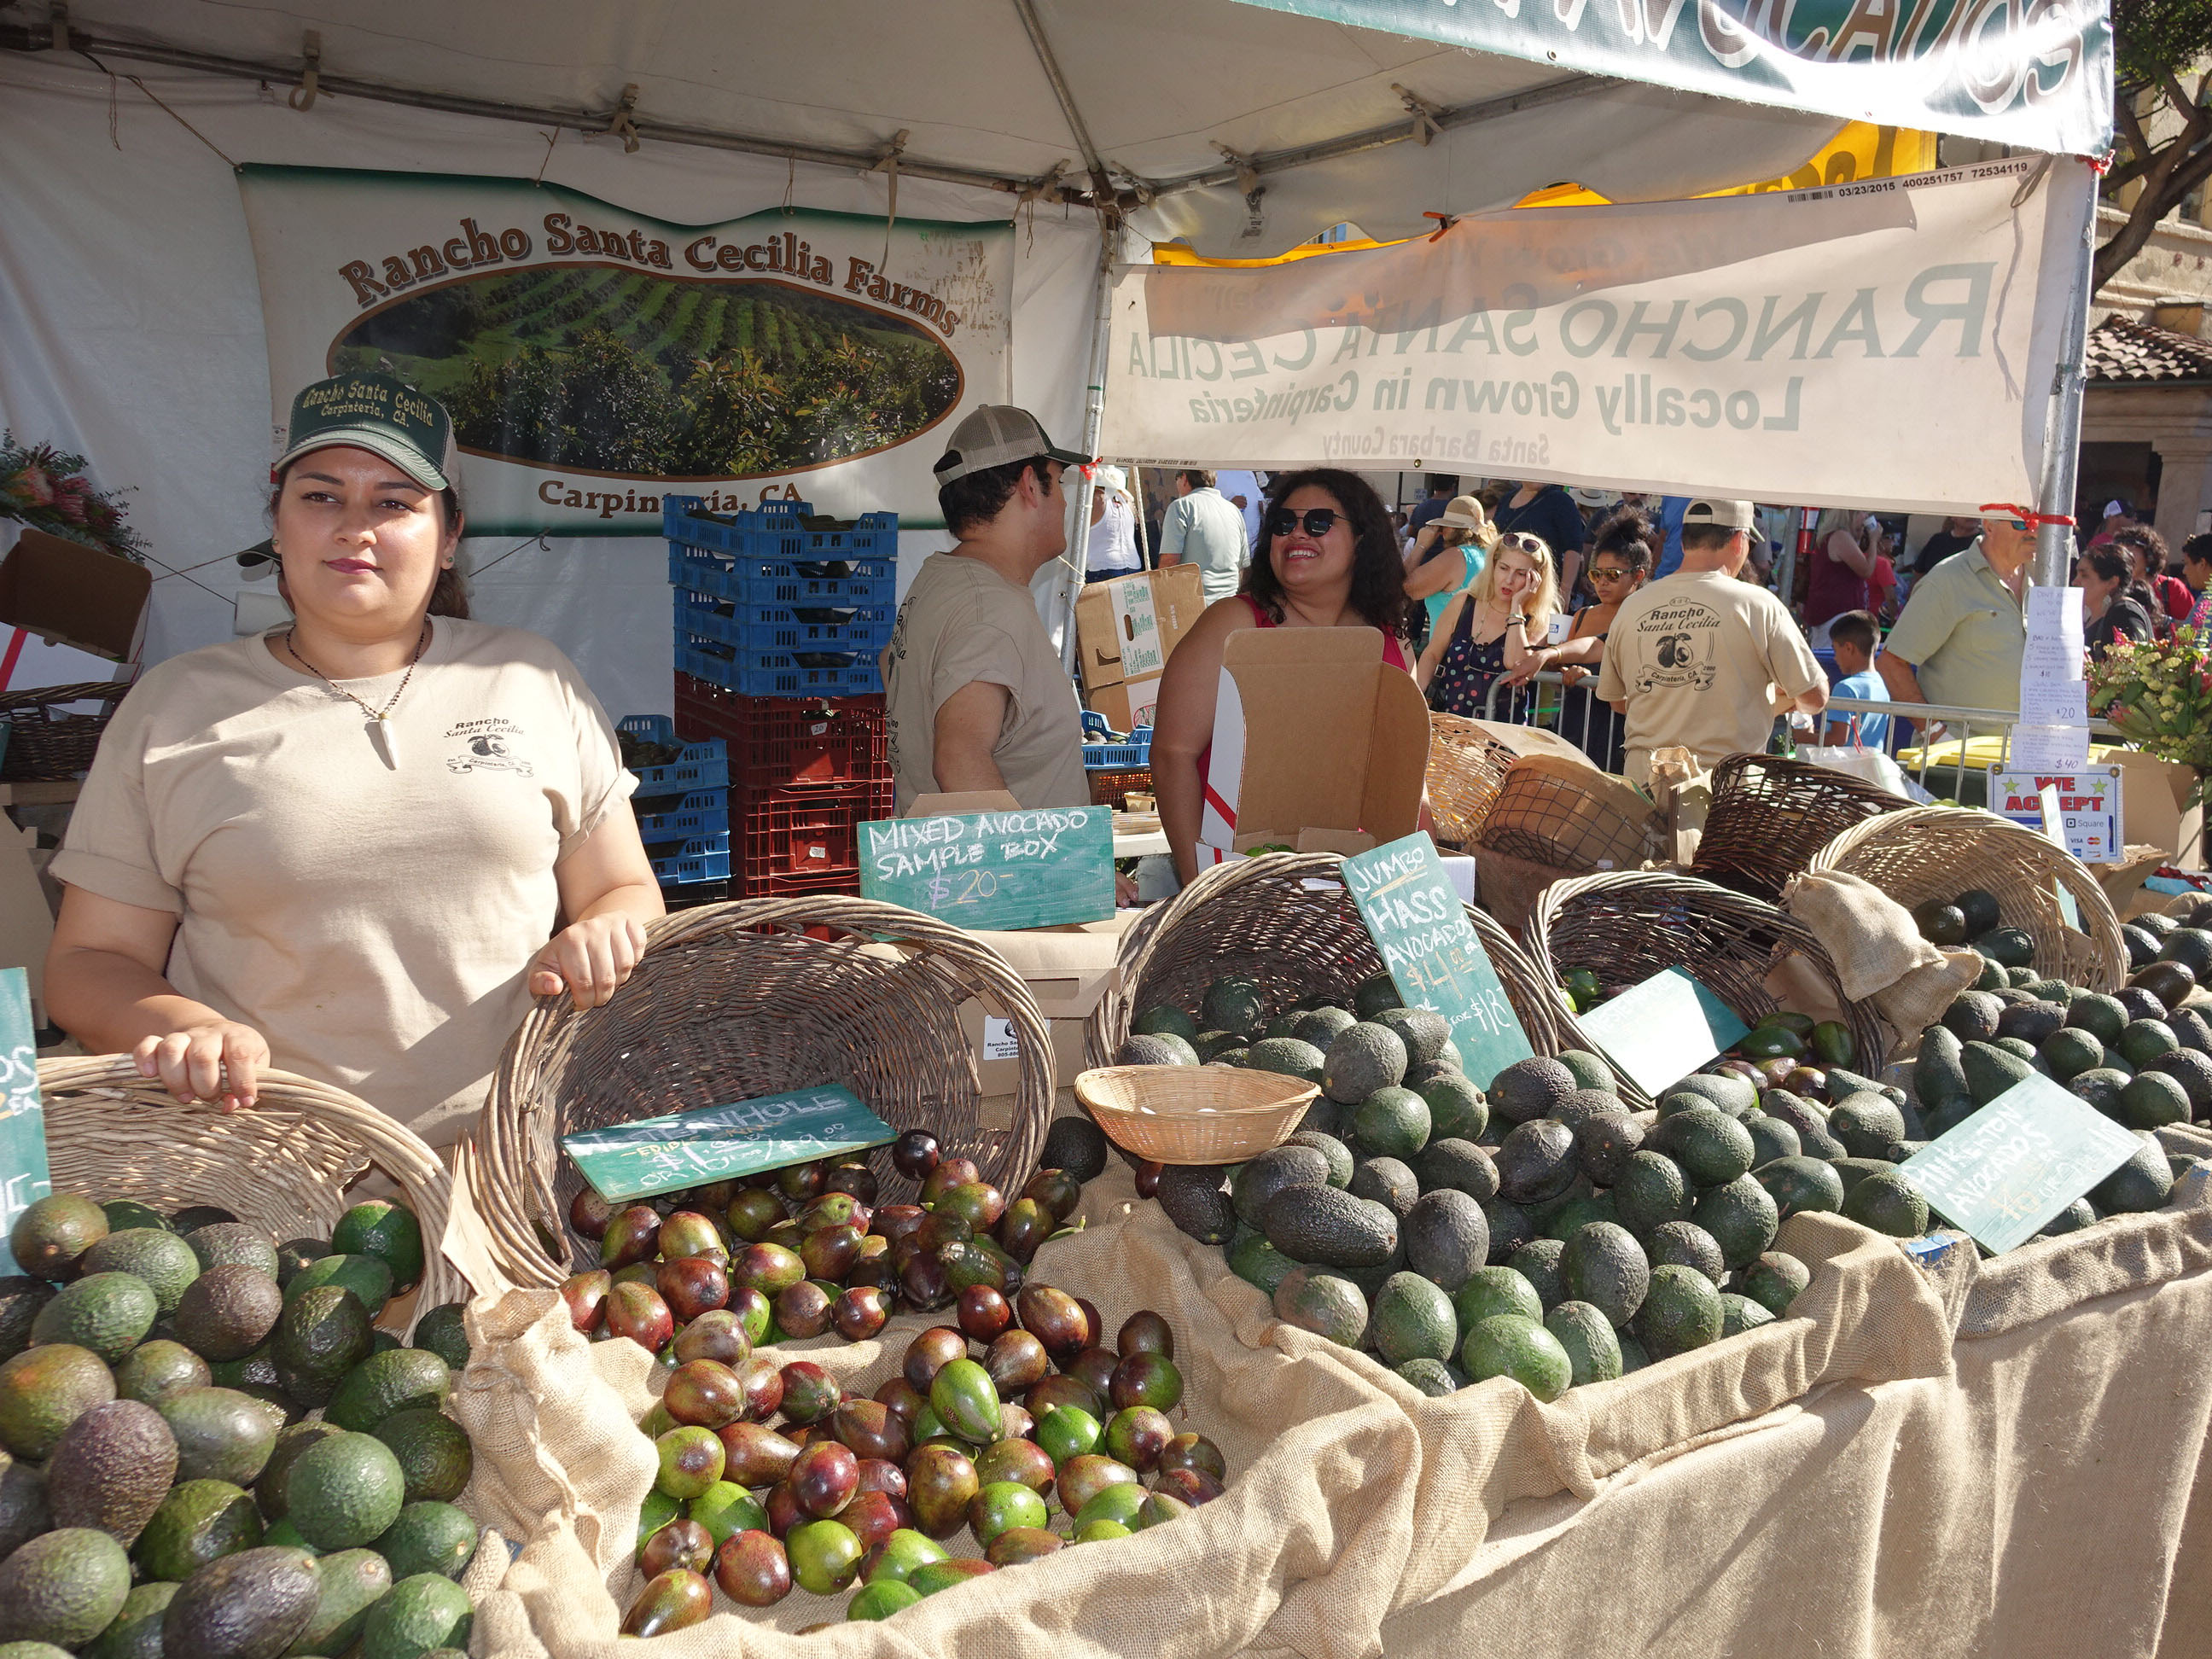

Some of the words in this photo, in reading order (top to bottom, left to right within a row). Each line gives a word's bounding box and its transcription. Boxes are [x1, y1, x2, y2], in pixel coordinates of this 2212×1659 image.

[1838, 182, 1895, 197] 03/23/2015
[1902, 172, 1964, 189] 400251757
[1970, 162, 2028, 178] 72534119
[339, 216, 531, 309] Rancho
[544, 212, 672, 271] Santa
[684, 231, 835, 287] Cecilia
[844, 255, 961, 338] Farms
[302, 384, 345, 409] Rancho
[347, 379, 387, 403] Santa
[394, 390, 434, 427] Cecilia
[321, 399, 384, 420] Carpinteria,
[392, 410, 410, 428] CA.
[1637, 620, 1674, 632] Santa
[1678, 615, 1721, 630] Cecilia
[1650, 607, 1705, 621] Rancho
[444, 727, 481, 738] Santa
[486, 724, 525, 736] Cecilia
[455, 718, 509, 729] Rancho
[2054, 758, 2079, 770] $40
[2034, 777, 2075, 792] WE
[2005, 796, 2104, 812] ACEPT
[868, 817, 964, 856] MIXED
[978, 811, 1089, 839] AVOCADO
[2077, 818, 2104, 829] Square
[875, 842, 986, 881] SAMPLE
[1000, 832, 1058, 862] BOX
[1352, 846, 1424, 894] JUMBO
[1368, 886, 1448, 934] HASS
[1382, 911, 1475, 975] AVOCADOS
